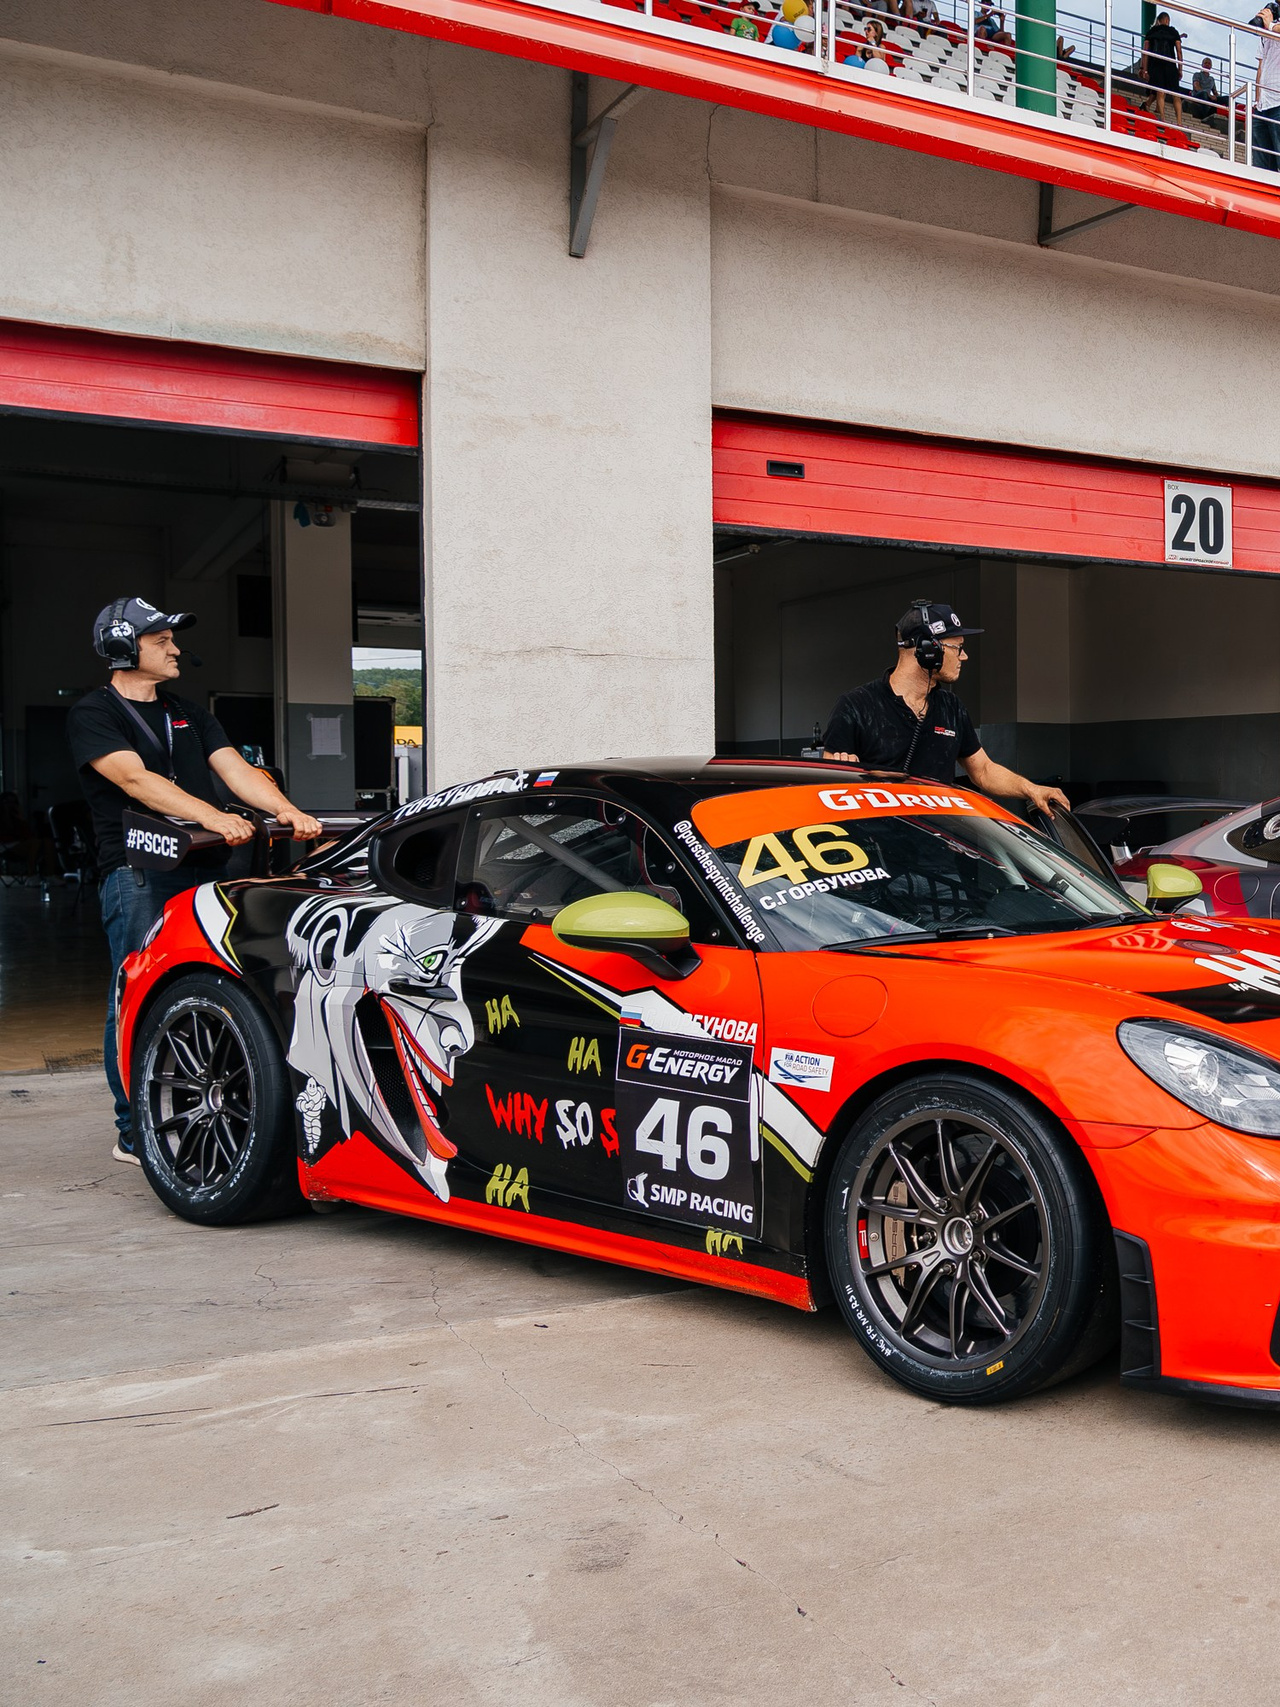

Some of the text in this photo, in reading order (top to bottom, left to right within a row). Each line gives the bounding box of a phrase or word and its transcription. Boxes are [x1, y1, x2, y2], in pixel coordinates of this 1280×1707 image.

[1171, 493, 1224, 555] 20
[127, 828, 178, 859] #PSCCE
[737, 824, 869, 888] 46
[673, 820, 767, 944] @porschesprintchallenge
[759, 867, 891, 911] С.ГОРБУНОВА
[485, 995, 520, 1034] HA
[567, 1036, 601, 1076] HA
[673, 1049, 743, 1066] МОТОРНОЕ МАСЛО
[792, 1064, 807, 1073] ROAD
[808, 1066, 829, 1075] SAFETY
[795, 1055, 820, 1066] ACTION
[485, 1083, 549, 1144] WHY
[555, 1100, 594, 1149] SO
[636, 1098, 733, 1180] 46
[485, 1163, 530, 1212] HA
[650, 1184, 753, 1224] SMP RACING
